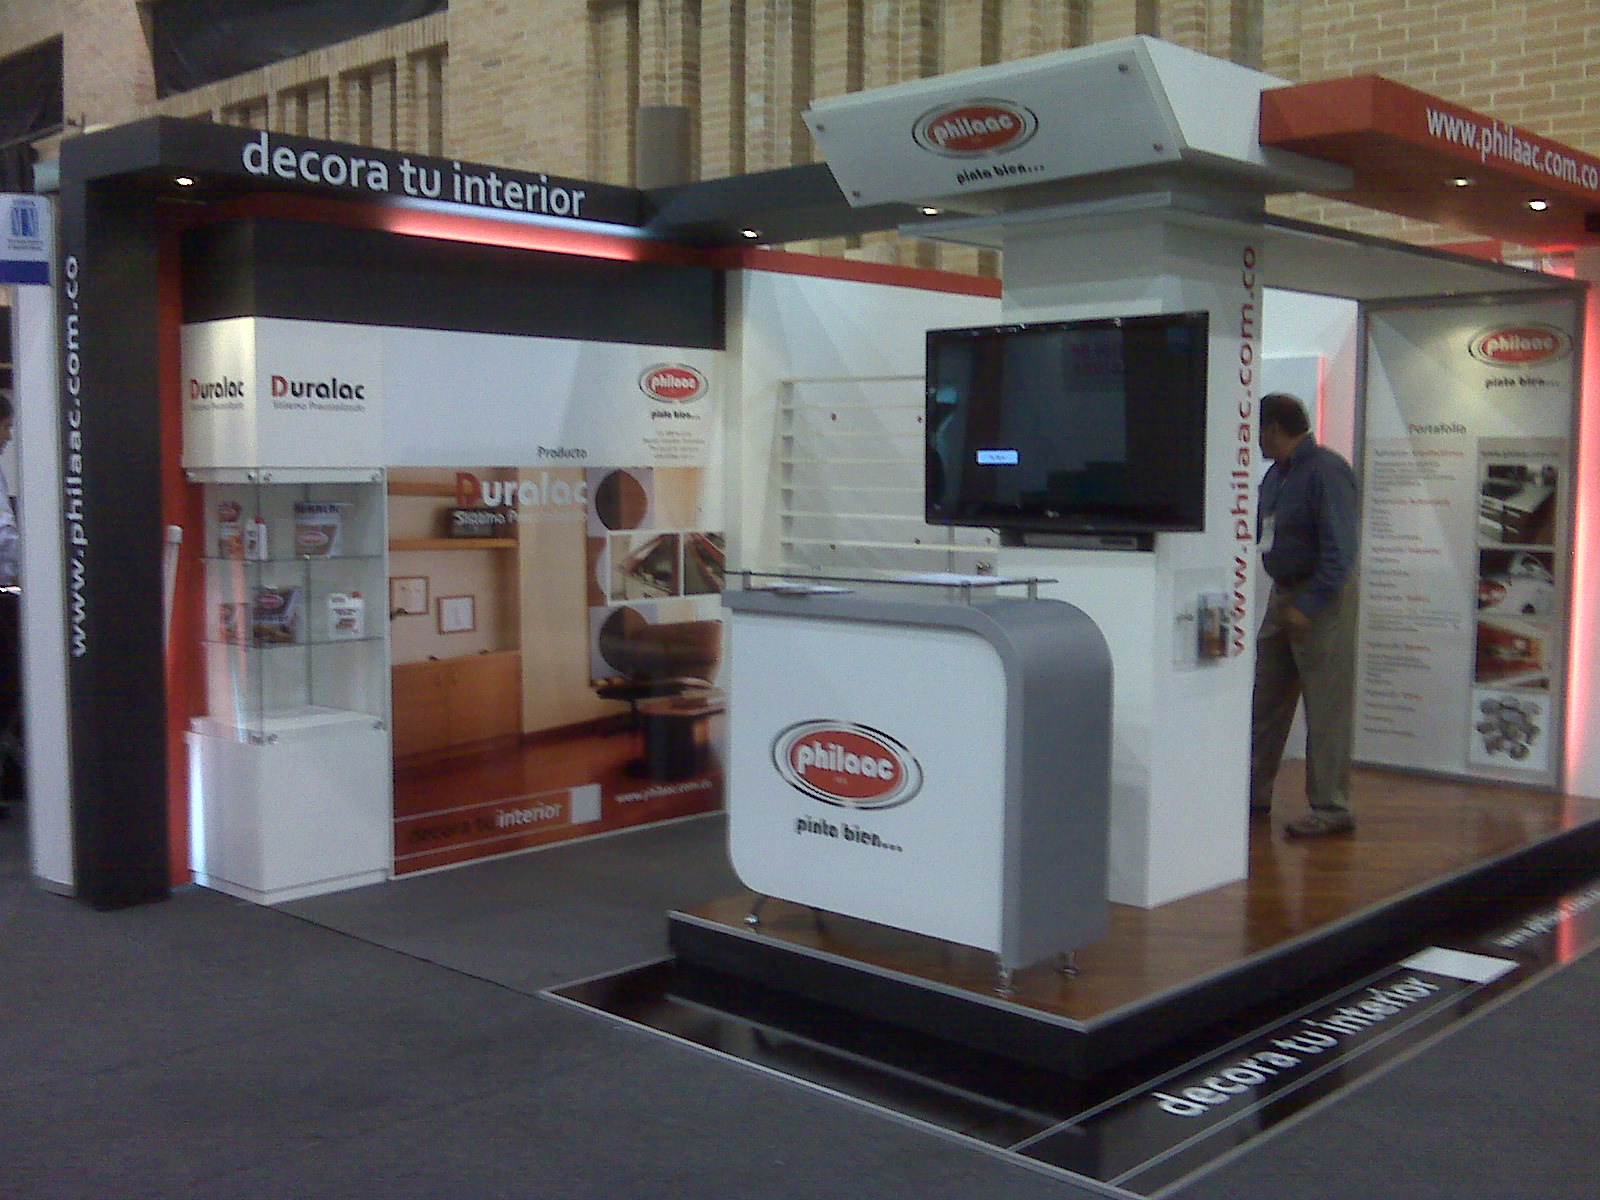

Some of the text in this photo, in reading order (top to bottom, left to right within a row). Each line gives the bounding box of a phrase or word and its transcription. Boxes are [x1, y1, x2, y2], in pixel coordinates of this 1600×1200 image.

[934, 111, 1016, 146] philaac
[1425, 107, 1600, 190] www.philaac.com.co
[242, 131, 586, 217] decora tu interior
[956, 169, 992, 186] pinta
[190, 375, 245, 400] Duralac
[271, 375, 366, 401] Duralac
[64, 256, 88, 657] www.philaac.com.co
[537, 445, 588, 460] Producto
[1230, 246, 1256, 656] www.philaac.com.co
[456, 471, 588, 508] Duralac
[797, 740, 895, 782] philaac
[496, 800, 564, 830] interior
[796, 815, 839, 836] pinta
[1151, 975, 1441, 1119] decora tu interior
